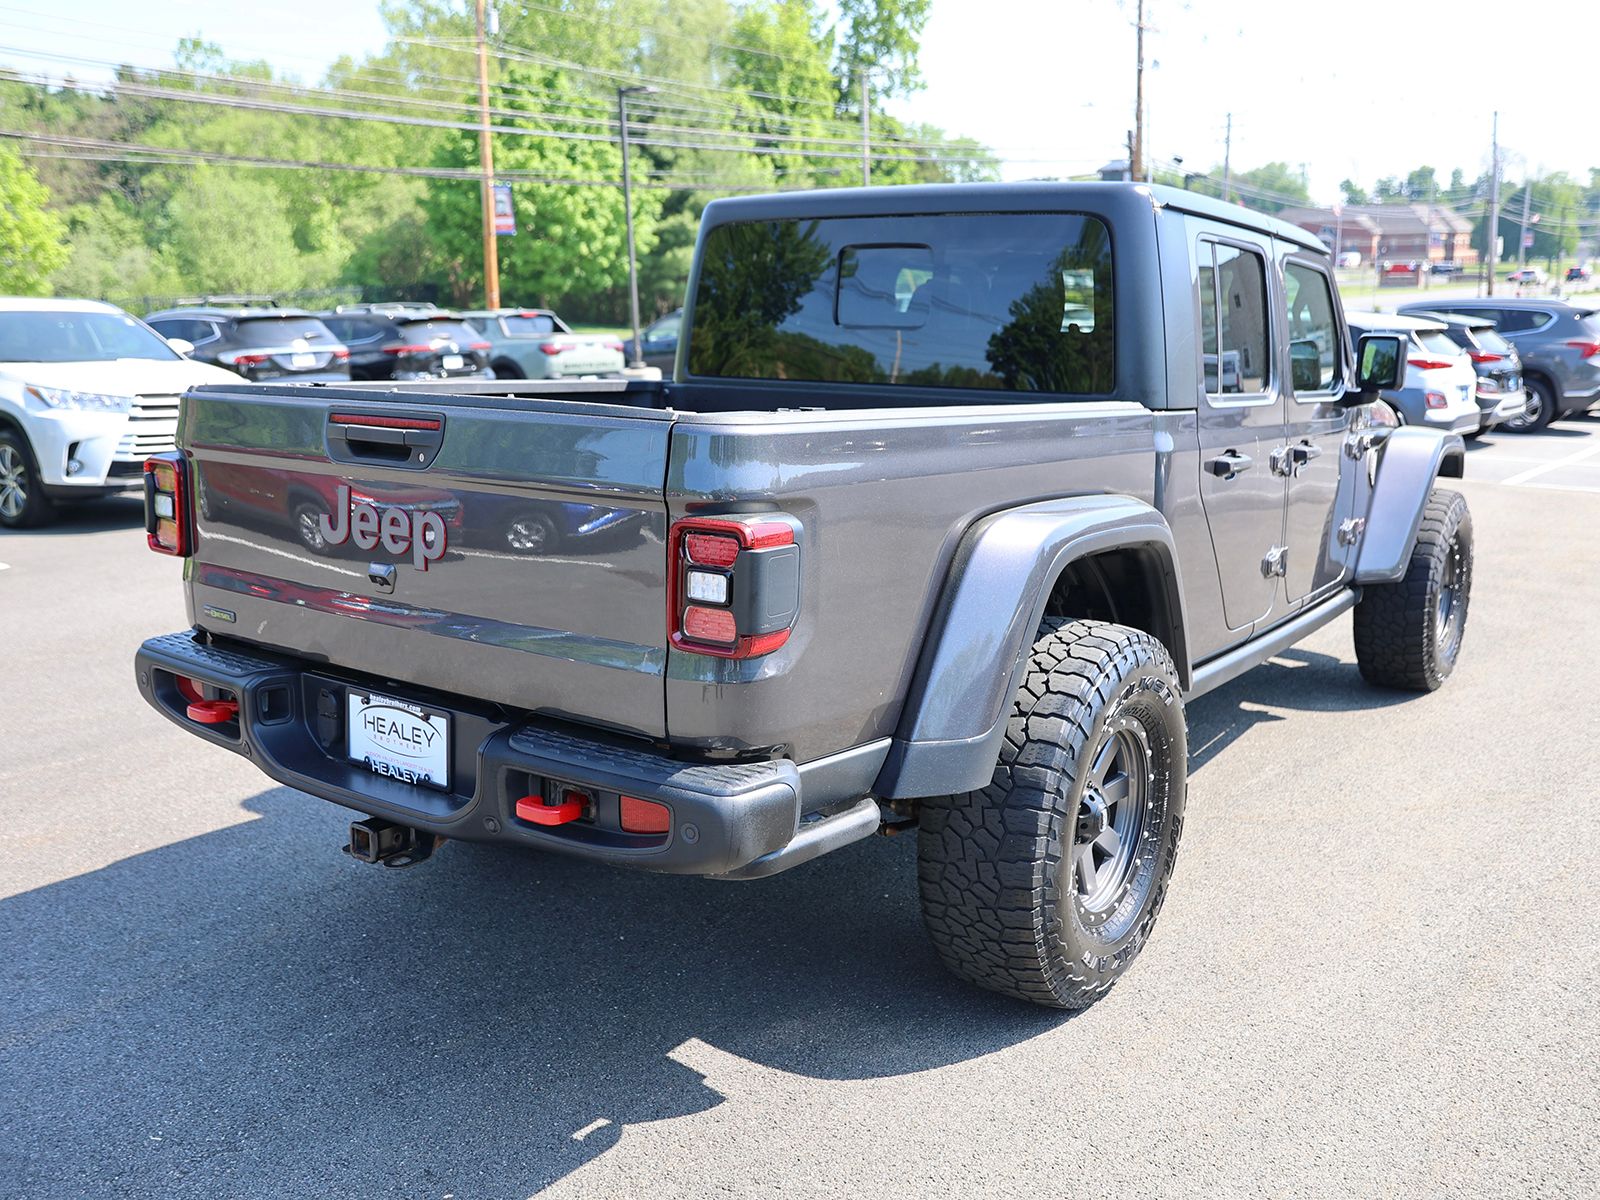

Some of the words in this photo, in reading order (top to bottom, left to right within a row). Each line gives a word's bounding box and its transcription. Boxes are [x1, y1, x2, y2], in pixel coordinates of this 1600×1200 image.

[319, 485, 447, 572] Jeep
[364, 713, 435, 748] HEALEY
[373, 734, 423, 753] BROTHERS
[371, 759, 420, 785] HEALEY
